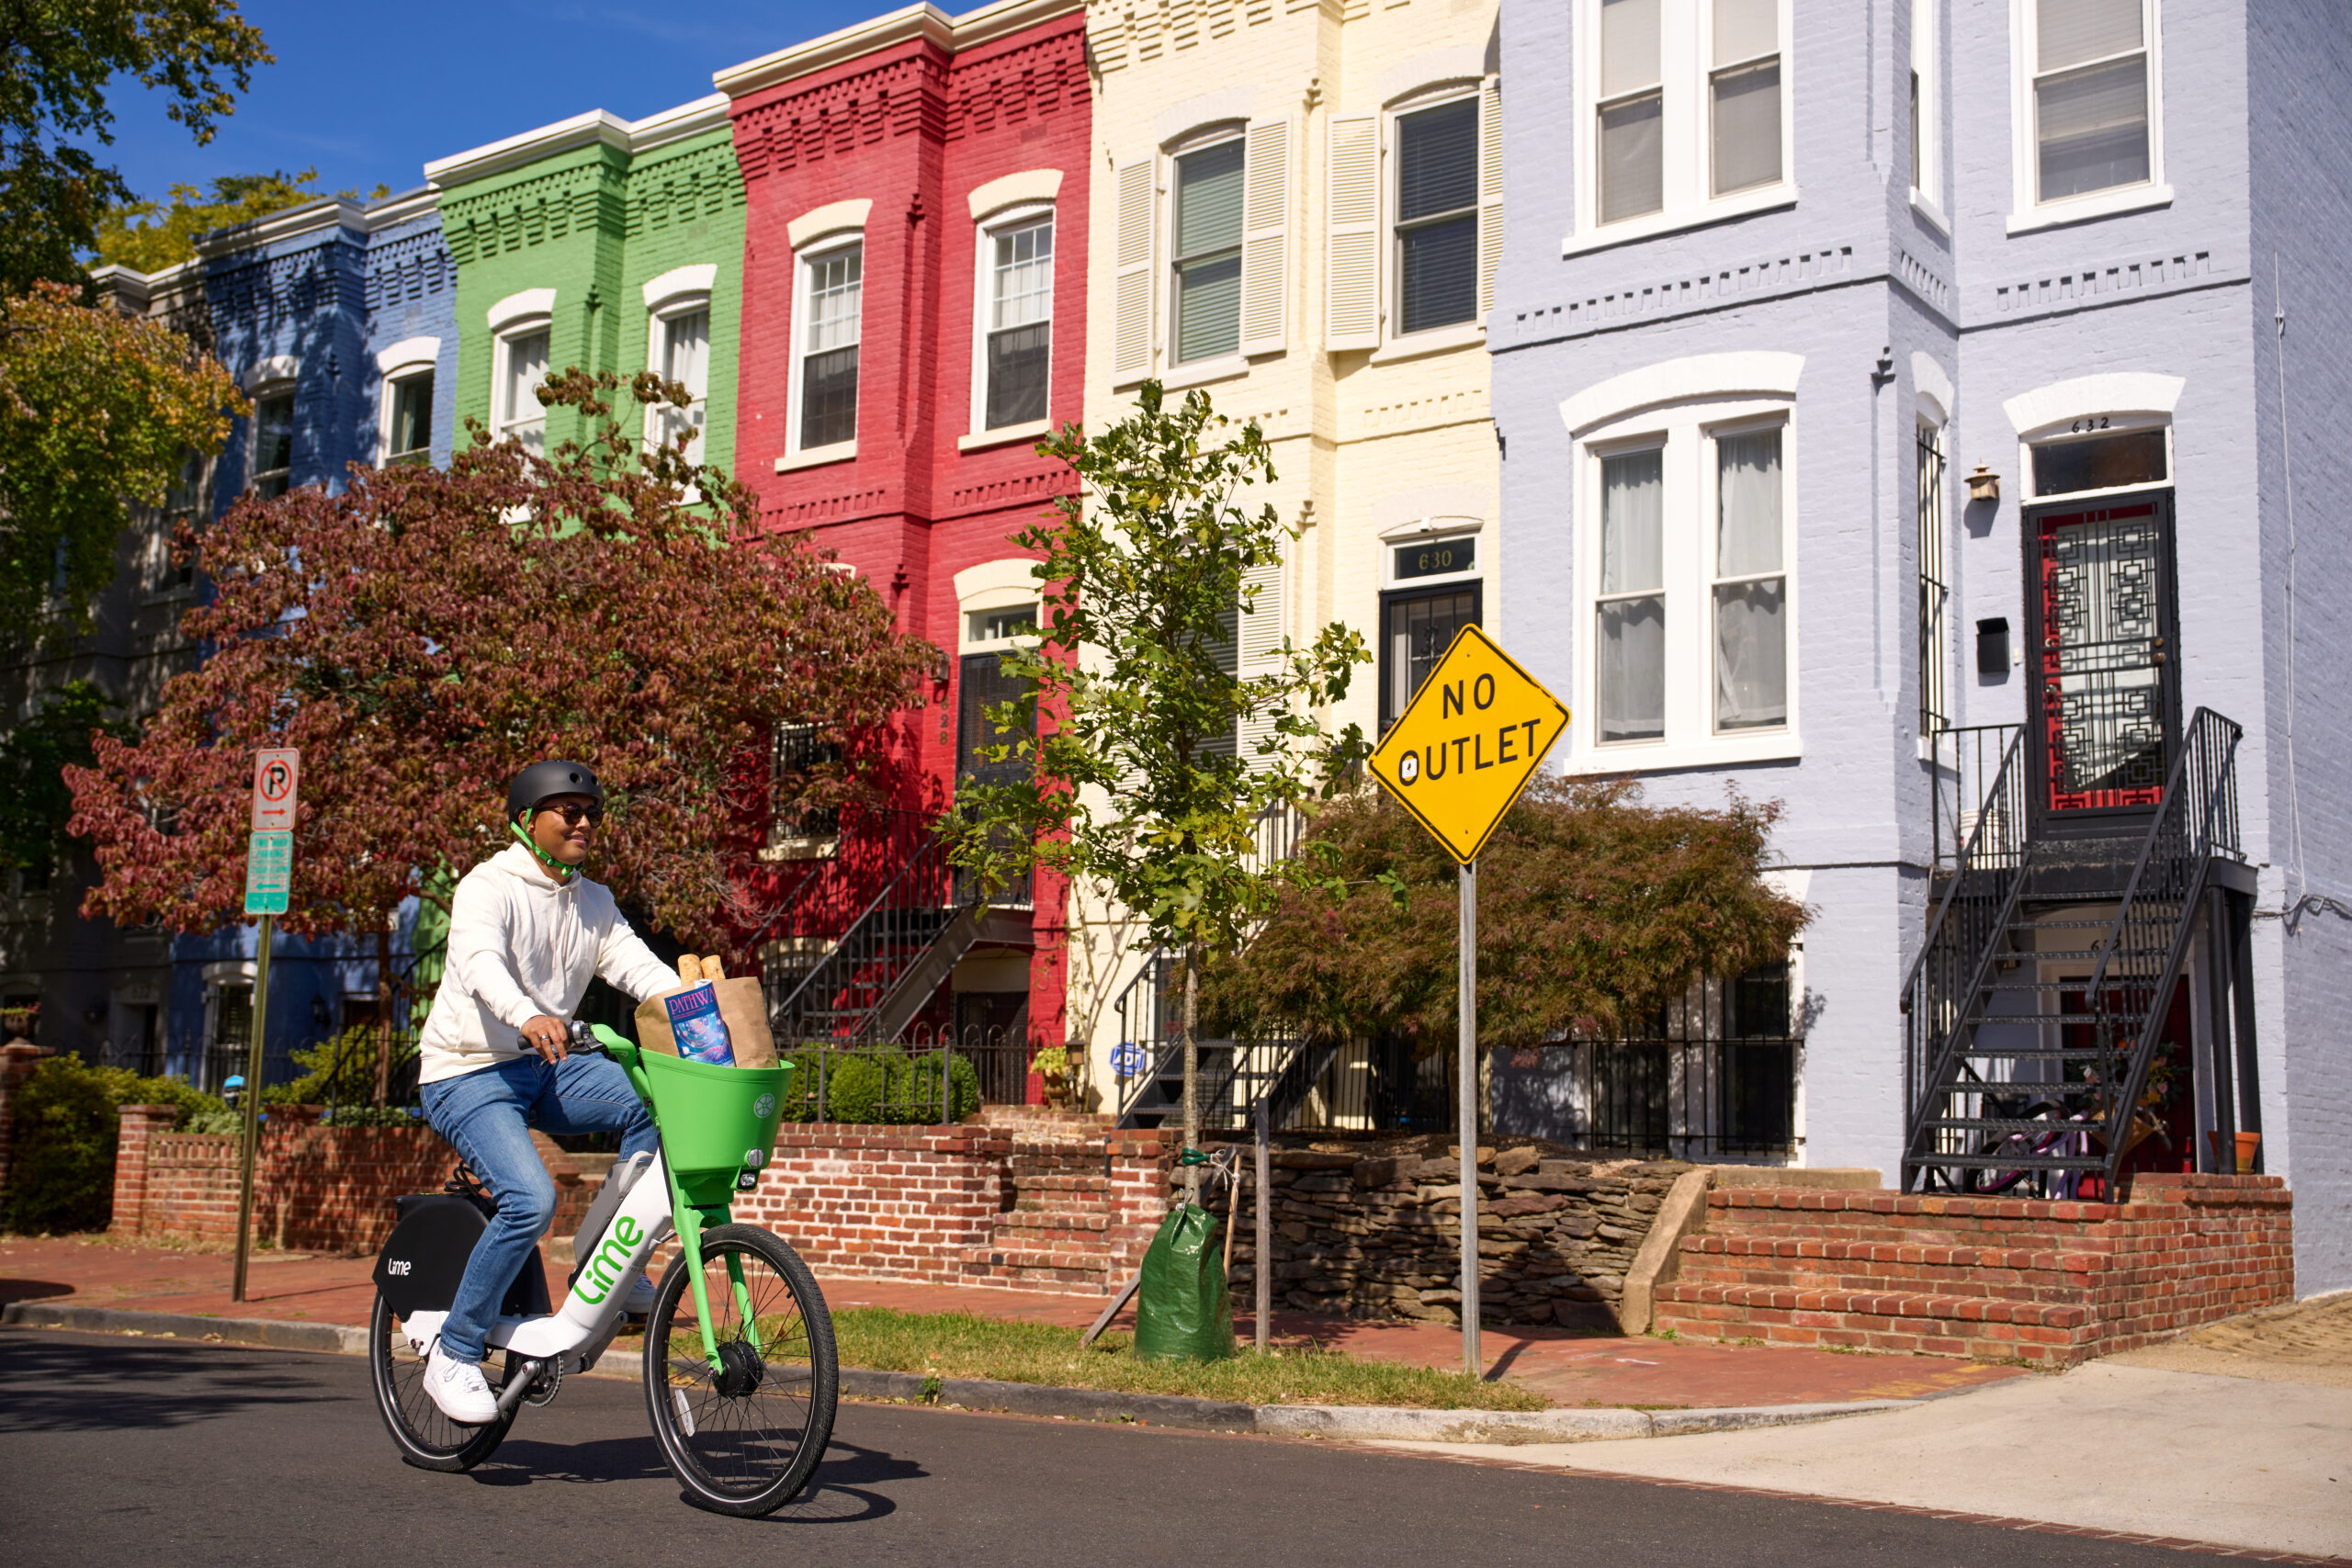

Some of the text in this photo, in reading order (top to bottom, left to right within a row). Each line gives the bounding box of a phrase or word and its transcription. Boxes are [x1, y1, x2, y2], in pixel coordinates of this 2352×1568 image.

[2071, 417, 2109, 434] 632
[1419, 550, 1453, 570] 630
[1442, 673, 1495, 719] NO
[940, 696, 949, 745] 628
[1398, 718, 1541, 786] OUTLET
[669, 986, 717, 1015] PATHWA
[389, 1258, 412, 1276] Lime
[573, 1216, 643, 1304] Lime
